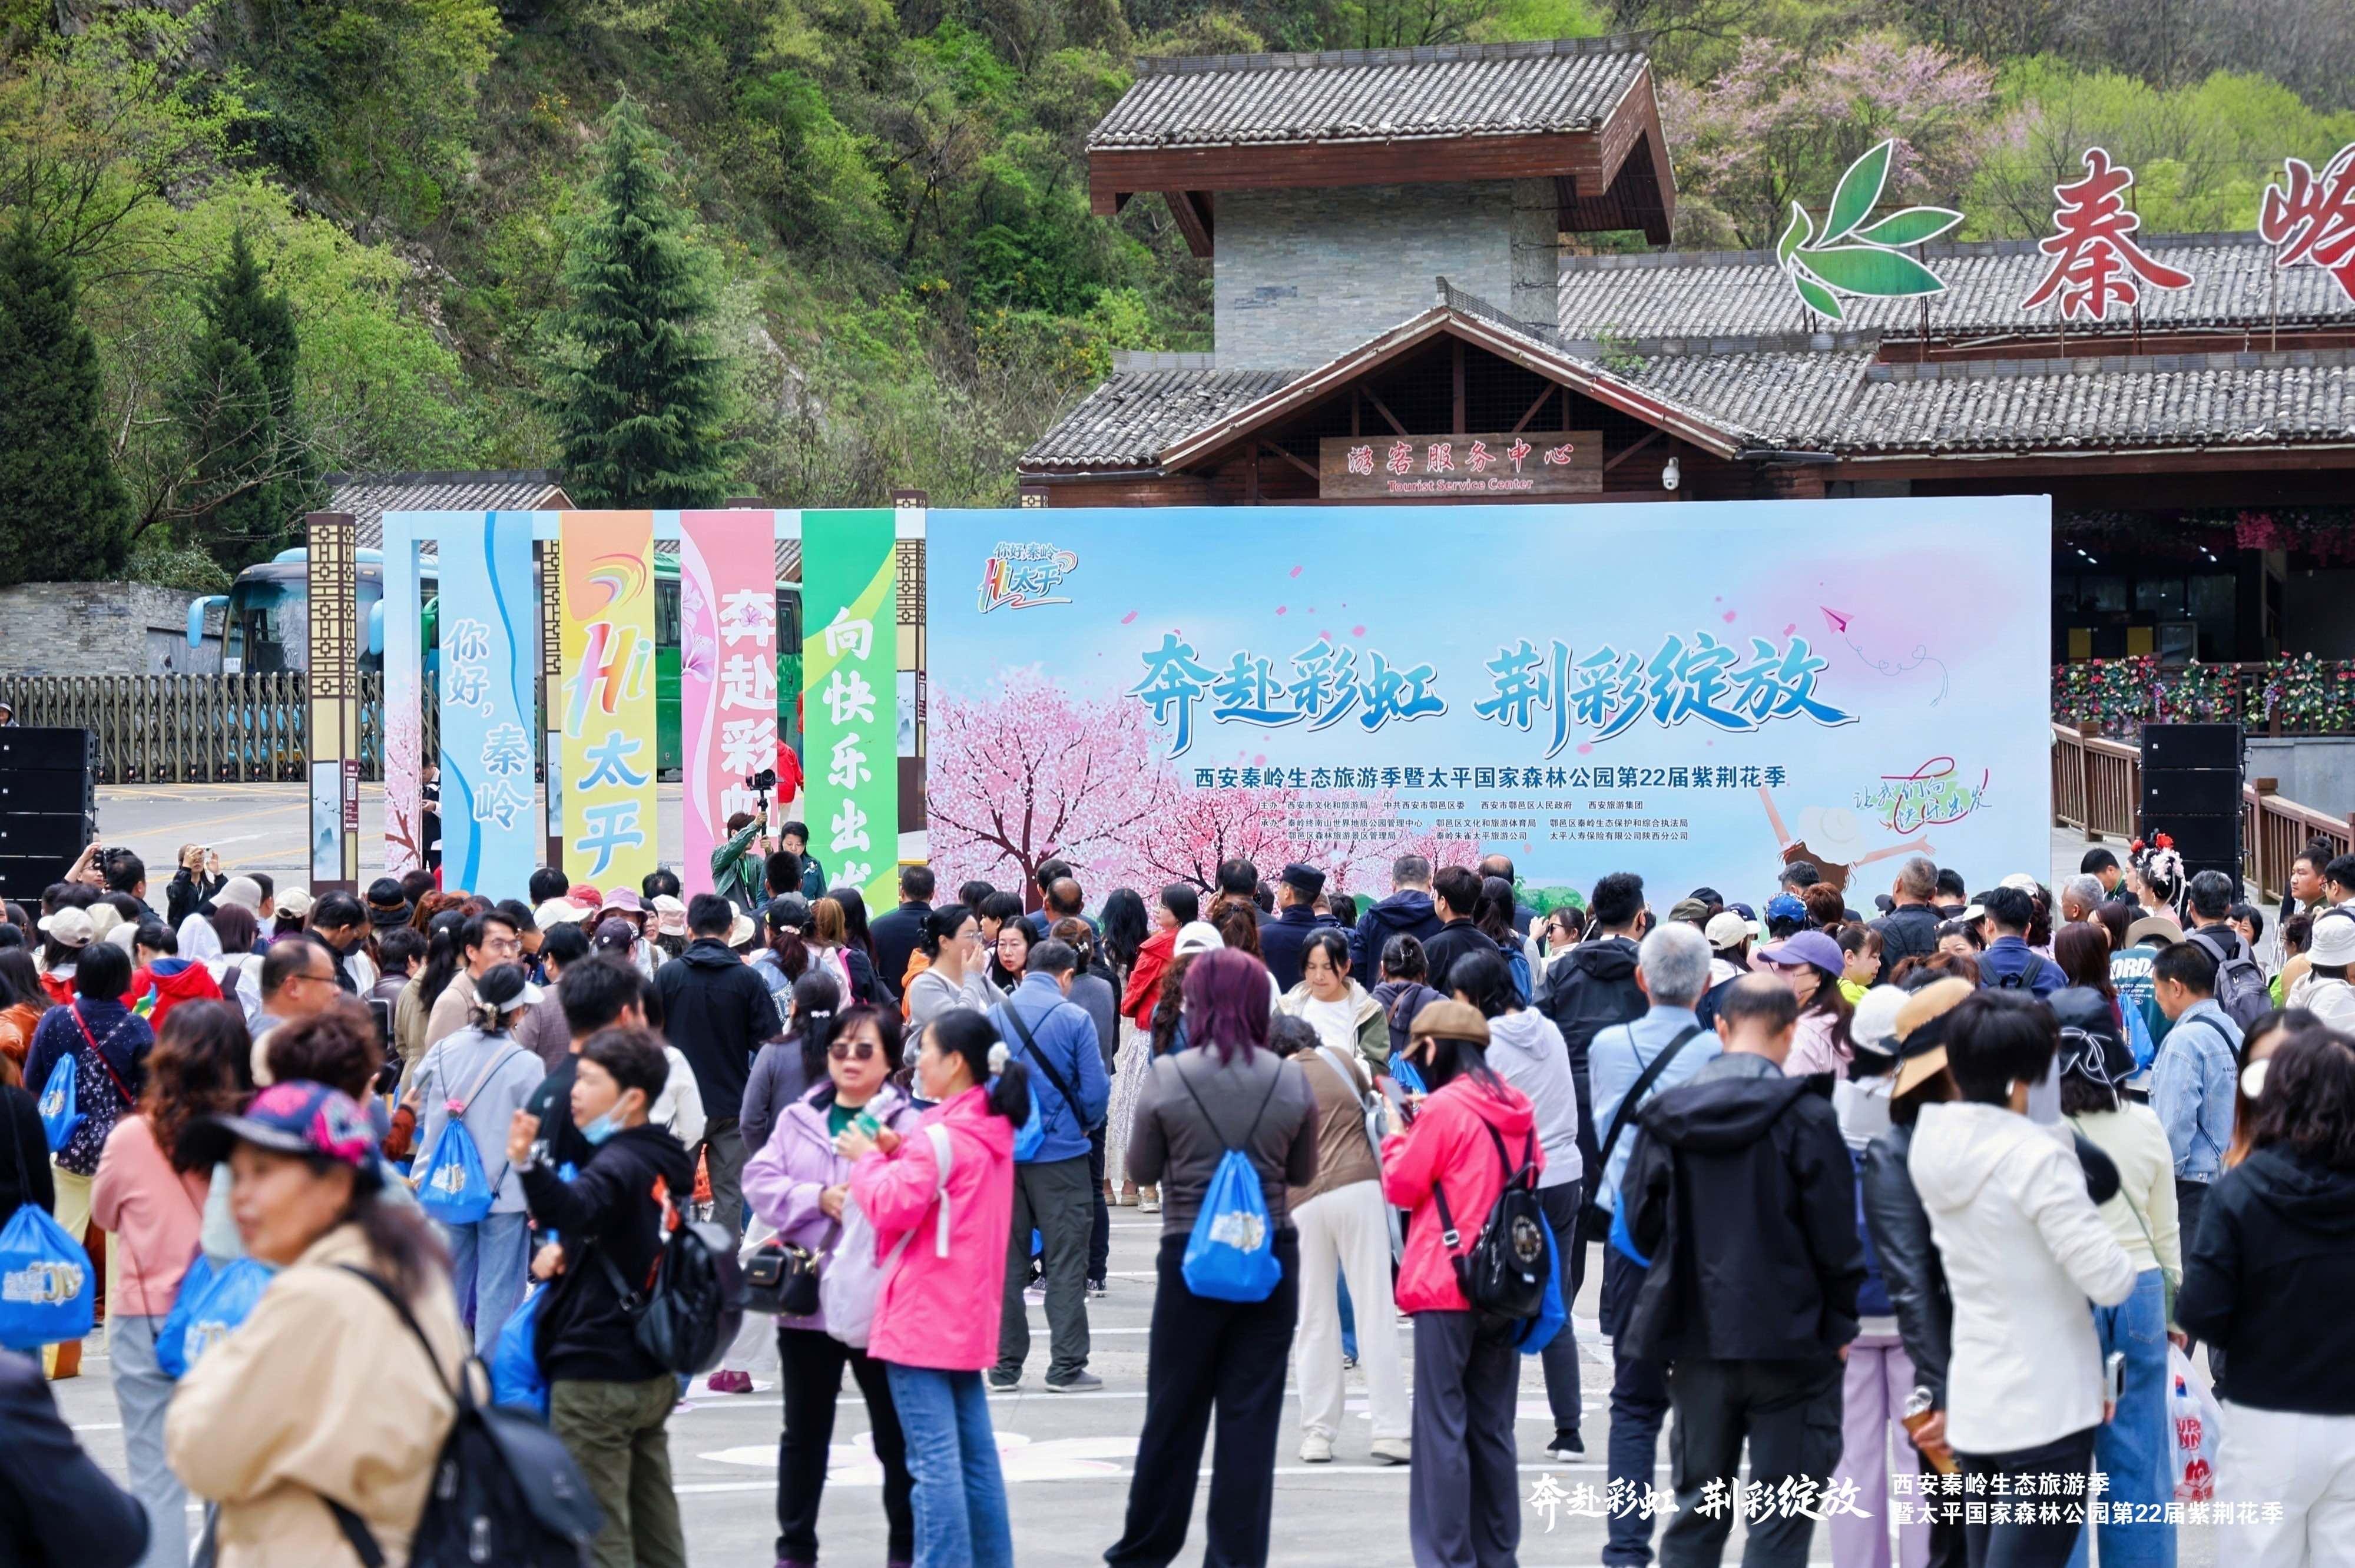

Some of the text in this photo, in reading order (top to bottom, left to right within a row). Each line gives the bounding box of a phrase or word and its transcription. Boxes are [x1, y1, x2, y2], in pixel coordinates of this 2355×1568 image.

[1347, 438, 1574, 475] 游客服务中心
[1387, 478, 1533, 492] Tourist Service Center
[1010, 563, 1063, 597] 太平
[561, 621, 654, 740] Hi
[1124, 631, 1860, 760] 奔赴彩虹 荆彩绽放
[473, 723, 533, 830] 秦岭
[1194, 766, 1787, 790] 西安秦岭生态旅游季暨太平国家森林公园第22届紫荆花季
[576, 731, 651, 878] 太平
[1287, 801, 1368, 810] 西安市文化和旅游局
[1588, 801, 1644, 810] 西安旅游集团
[1436, 831, 1528, 841] 秦岭朱雀太平旅游公司
[1549, 831, 1688, 841] 太平人寿保险有限公司陕西分公司
